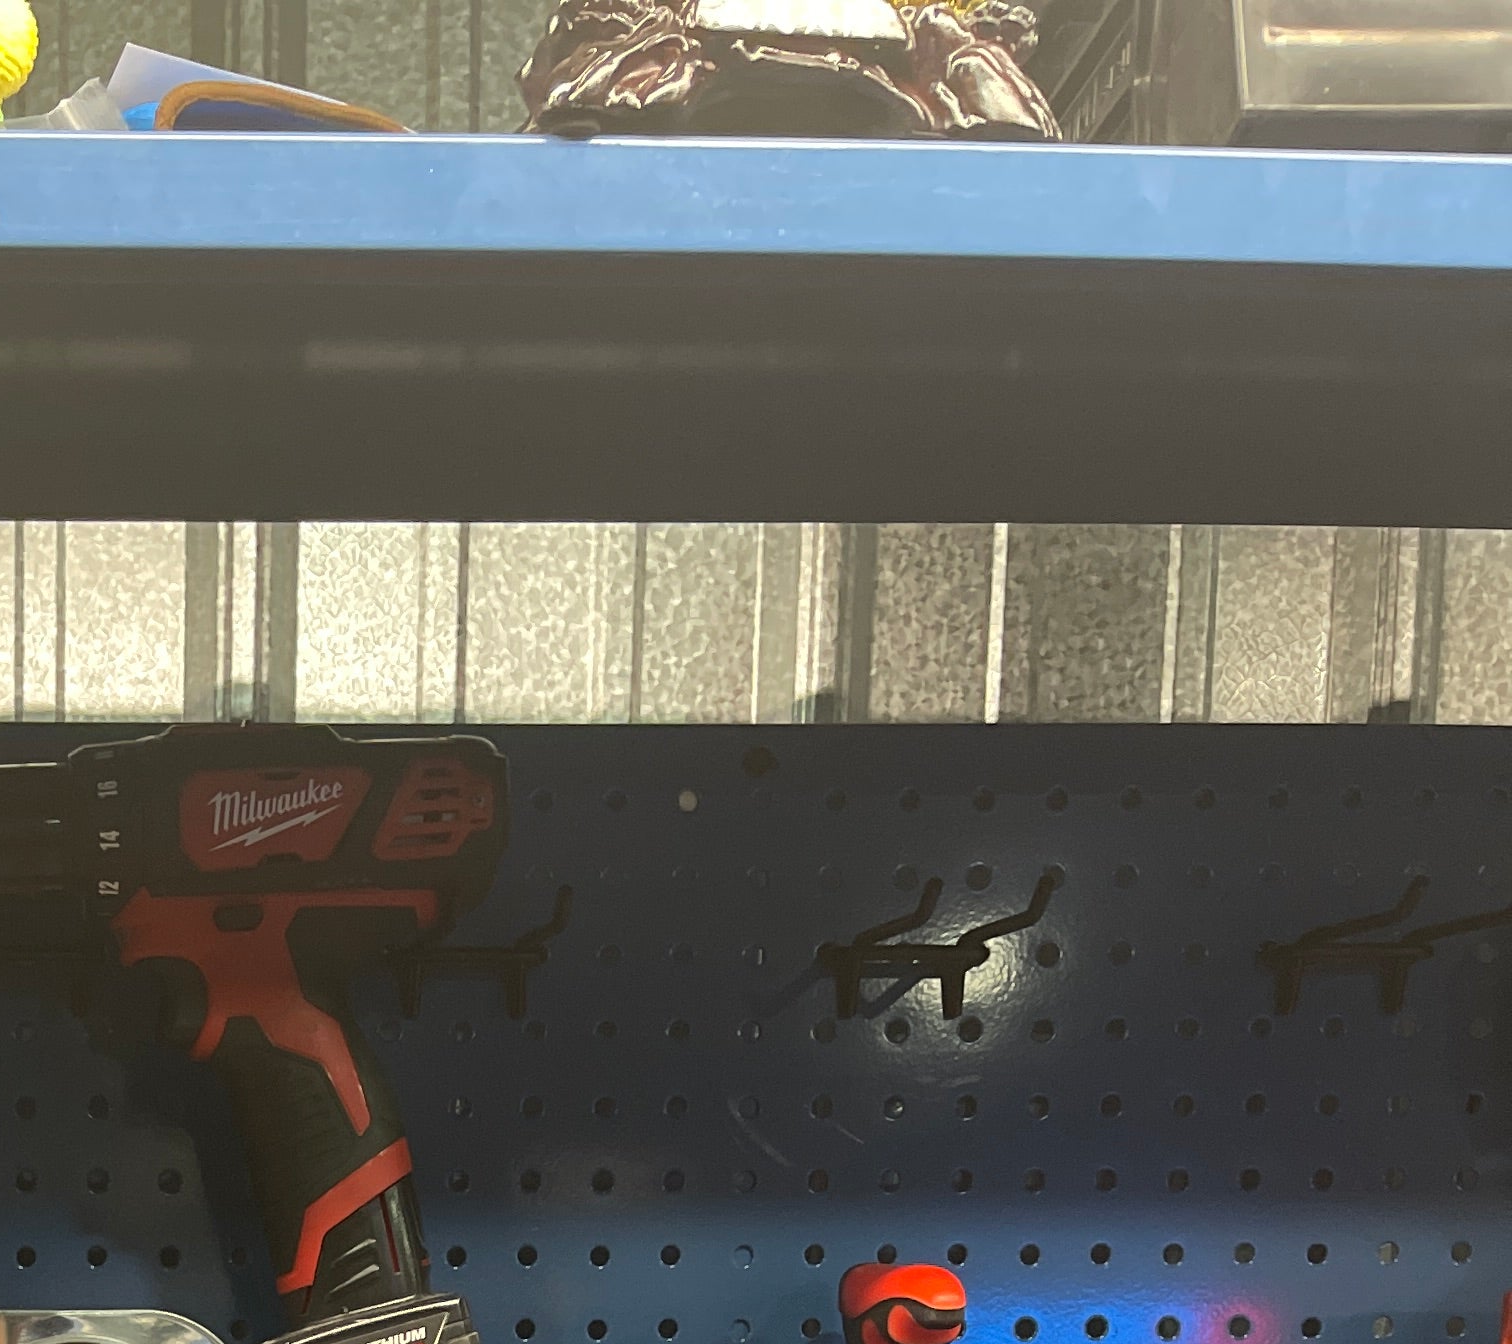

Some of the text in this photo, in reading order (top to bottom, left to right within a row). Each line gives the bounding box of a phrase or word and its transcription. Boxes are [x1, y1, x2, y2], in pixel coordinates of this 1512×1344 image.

[208, 779, 344, 836] Milwaukee
[99, 830, 121, 851] 14
[98, 879, 120, 897] 12
